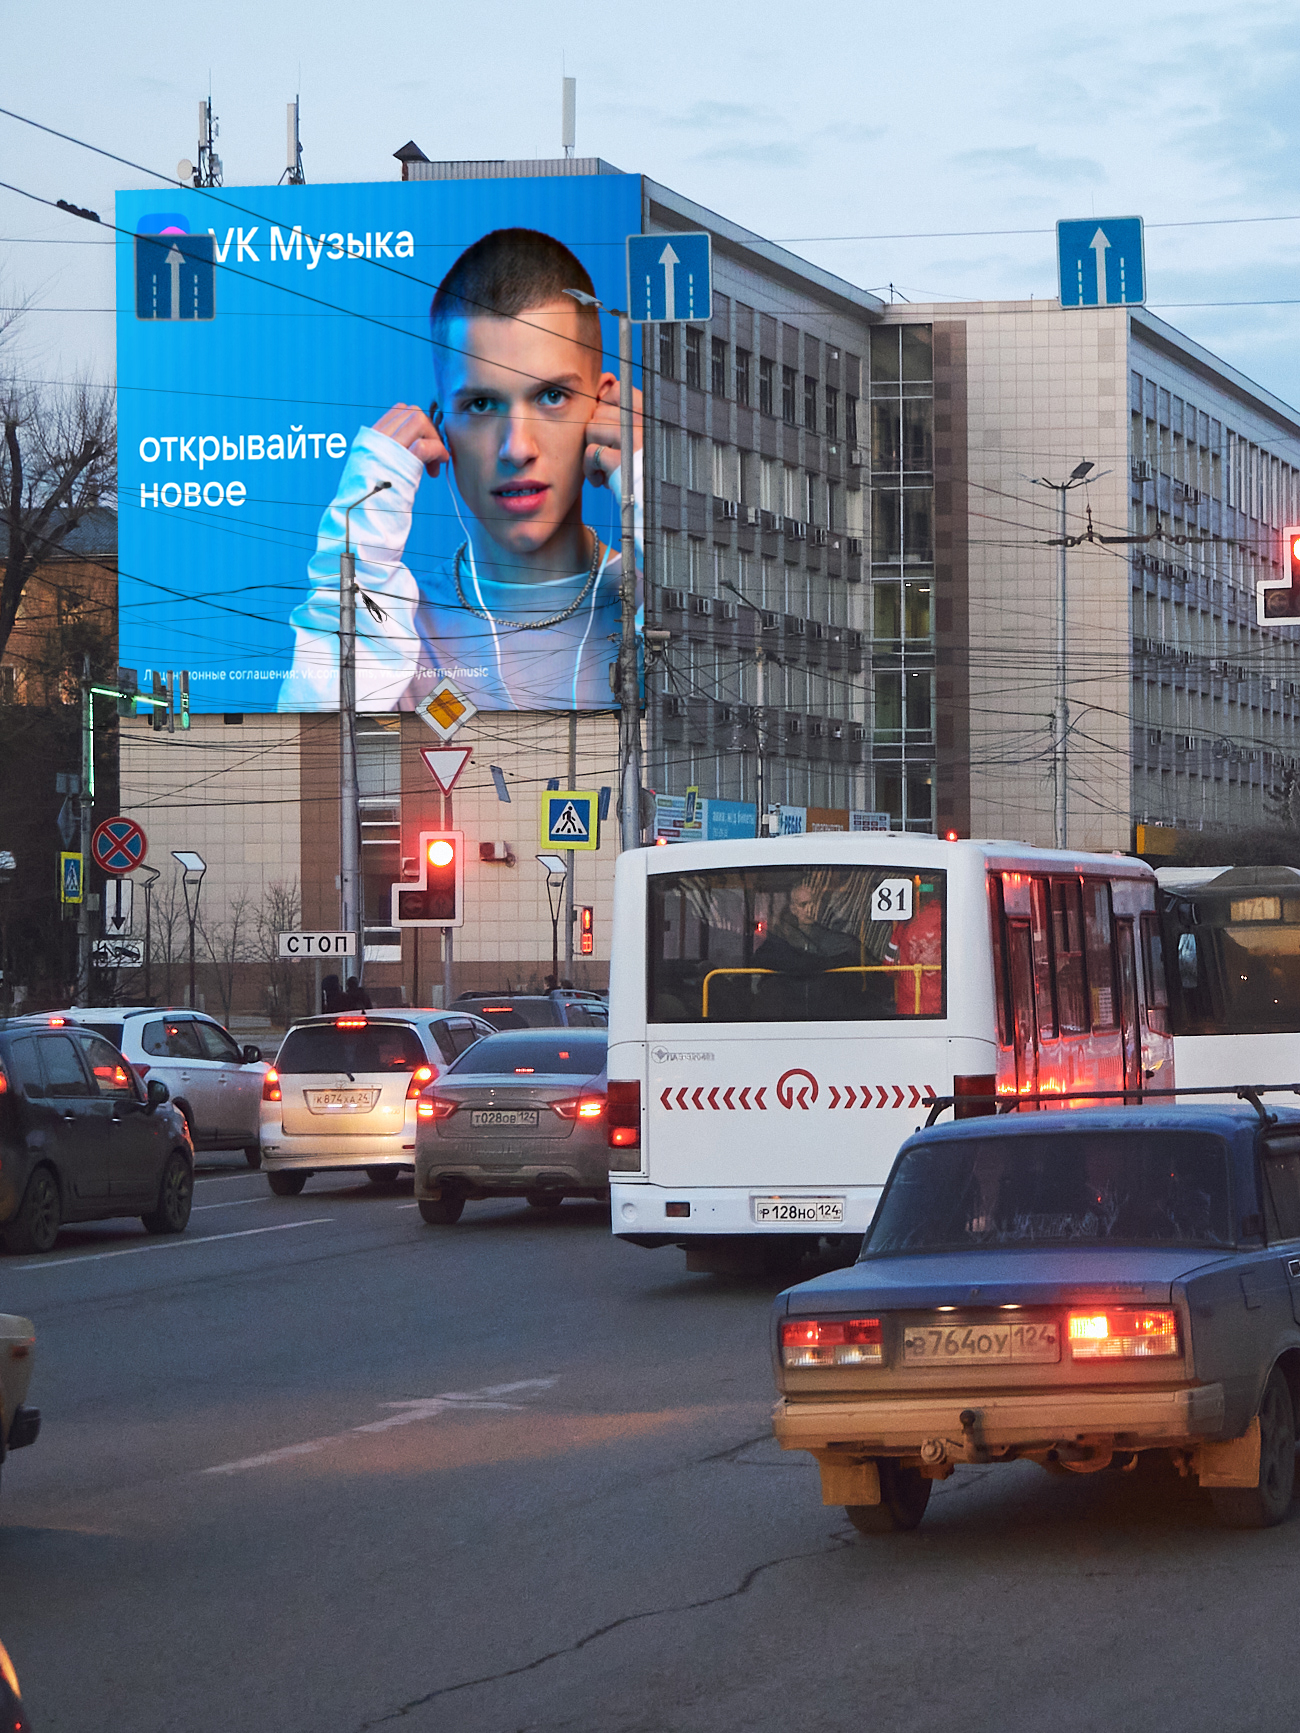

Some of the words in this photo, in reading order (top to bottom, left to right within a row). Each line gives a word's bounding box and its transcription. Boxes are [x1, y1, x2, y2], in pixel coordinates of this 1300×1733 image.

[208, 226, 259, 263] VK
[270, 225, 415, 270] Музыка
[139, 424, 347, 470] открывайте
[140, 480, 247, 507] новое
[144, 668, 226, 682] Лцнонные
[229, 668, 299, 681] соглашения:
[877, 887, 907, 911] 81
[287, 936, 347, 953] СТОП
[316, 1094, 356, 1104] К874ХА
[358, 1093, 369, 1102] 24
[475, 1112, 517, 1124] Т028ОВ
[519, 1112, 536, 1121] 124
[762, 1205, 816, 1219] Р128НО
[818, 1204, 839, 1216] 124
[912, 1328, 1008, 1356] В764ОУ
[1014, 1326, 1051, 1347] 124
